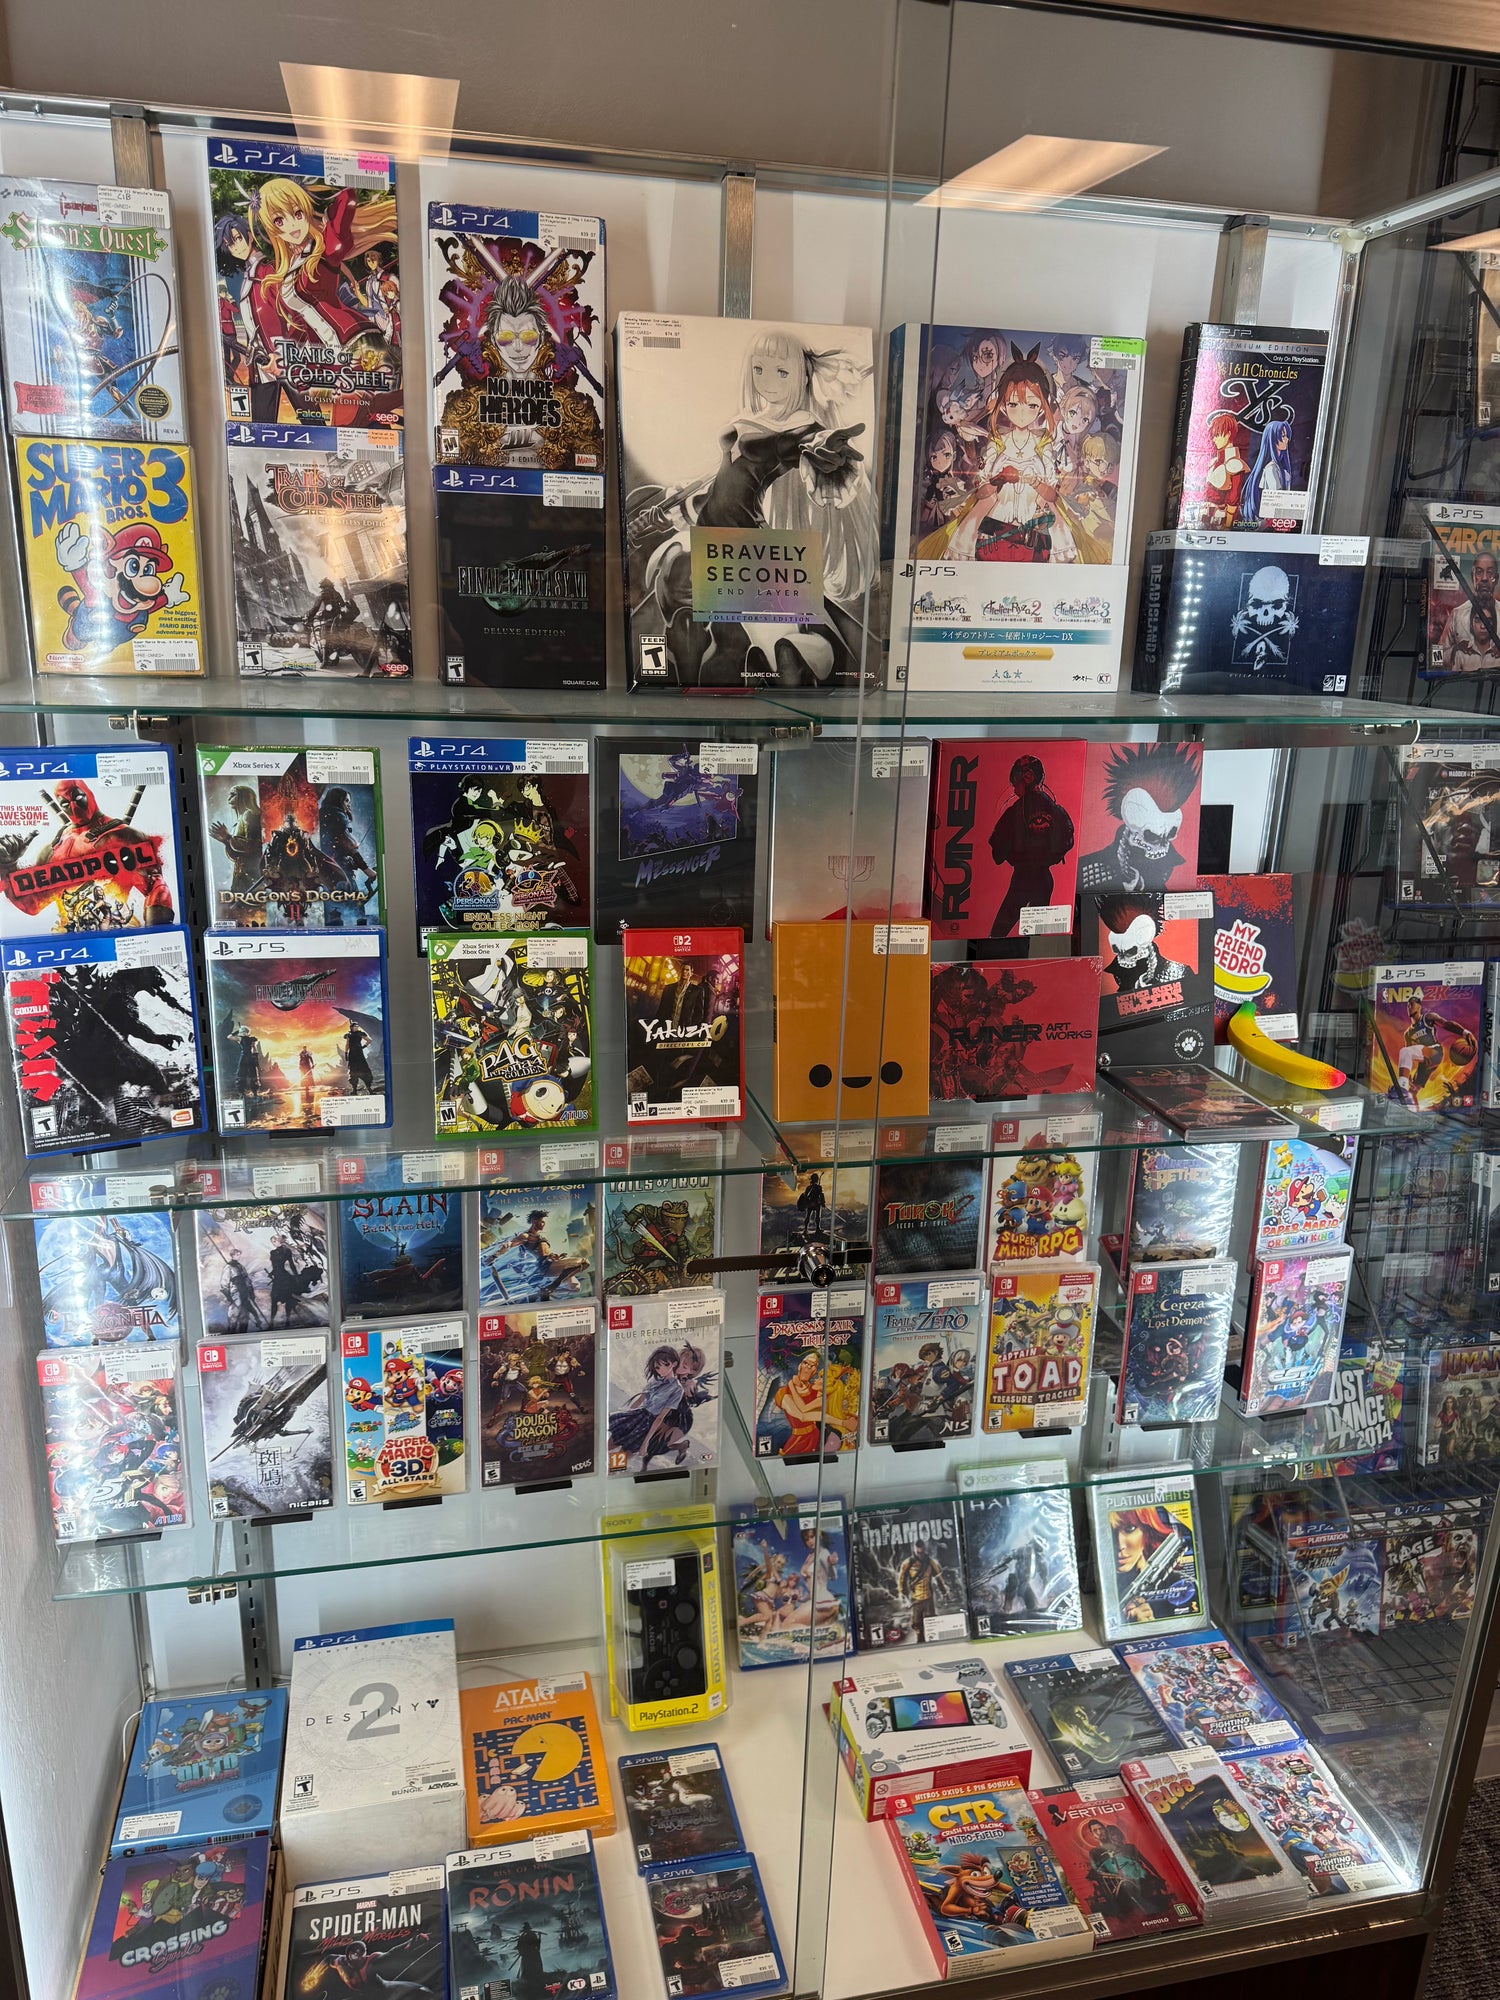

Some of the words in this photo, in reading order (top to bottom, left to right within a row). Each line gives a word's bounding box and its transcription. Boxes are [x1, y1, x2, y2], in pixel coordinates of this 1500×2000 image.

[244, 149, 300, 168] PS4
[461, 212, 512, 229] PS4
[274, 340, 335, 365] TRAILS
[337, 352, 353, 363] OF
[287, 363, 336, 389] COLD
[339, 367, 393, 392] STEEL
[511, 378, 553, 398] MORE
[339, 397, 371, 406] EDITION
[479, 395, 562, 428] HEROES
[261, 430, 314, 444] PS4
[26, 443, 147, 491] SUPER
[146, 448, 189, 524] 3
[469, 474, 519, 488] PS4
[29, 475, 147, 538] MARIO
[333, 489, 382, 514] STEEL
[105, 506, 148, 524] BROS.
[1453, 509, 1483, 518] PS5
[1197, 536, 1227, 545] PS5
[707, 544, 806, 561] BRAVELY
[707, 567, 807, 584] SECOND
[919, 566, 957, 577] PS5
[458, 566, 500, 595] FINAL
[507, 567, 574, 598] FANTASY
[758, 589, 799, 597] LAYER
[483, 627, 521, 636] DELUXE
[525, 628, 567, 637] EDITION
[941, 632, 995, 640] ライザのアトリエ
[1062, 633, 1073, 641] DX
[440, 745, 488, 756] PS4
[1424, 749, 1454, 758] PS5
[16, 762, 70, 775] PS4
[943, 755, 978, 920] RUINER
[14, 845, 151, 893] DEADPOOL
[635, 845, 721, 888] MESSENGER
[219, 890, 300, 904] DRAGON'S
[305, 890, 368, 903] DOGMA
[463, 912, 511, 922] ENDLESS
[513, 911, 548, 921] NIGHT
[472, 922, 540, 931] COLLECTION
[1234, 923, 1255, 941] MY
[238, 942, 286, 953] PS5
[684, 935, 691, 946] 2
[1217, 933, 1262, 961] FRIEND
[36, 947, 92, 962] PS4
[1214, 950, 1261, 974] PEDRO
[1397, 970, 1425, 978] PS5
[14, 1004, 48, 1016] GODZILLA
[1046, 1022, 1071, 1032] ART
[1046, 1030, 1092, 1040] WORKS
[560, 1111, 588, 1120] ATLUS
[352, 1193, 447, 1218] SLAIN
[361, 1223, 391, 1234] Back
[416, 1219, 441, 1231] Hell
[1261, 1222, 1300, 1237] PAPER
[1301, 1218, 1340, 1232] MARIO
[1001, 1231, 1037, 1246] SUPER
[1038, 1228, 1080, 1255] RPG
[1267, 1234, 1308, 1249] ORIGAMI
[1310, 1231, 1334, 1243] KING
[998, 1244, 1036, 1259] MARIO
[1160, 1299, 1205, 1313] Cereza
[1147, 1317, 1170, 1328] Lost
[615, 1330, 637, 1340] BLUE
[997, 1348, 1037, 1363] CAPTAIN
[993, 1359, 1082, 1391] TOAD
[992, 1394, 1033, 1404] TREASURE
[1038, 1388, 1079, 1402] TRACKER
[515, 1413, 557, 1428] DOUBLE
[940, 1420, 969, 1434] NIS
[1325, 1394, 1386, 1449] DANCE
[513, 1423, 558, 1440] DRAGON
[1356, 1421, 1393, 1449] 2014
[386, 1436, 428, 1449] SUPER
[378, 1445, 436, 1462] MARIO
[611, 1453, 625, 1467] 12
[391, 1461, 423, 1478] 3D
[289, 1499, 329, 1508] nicalis
[1106, 1490, 1164, 1507] PLATINUM
[1164, 1491, 1190, 1501] HITS
[862, 1519, 953, 1546] inFAMOUS
[320, 1635, 358, 1646] PS4
[1136, 1641, 1169, 1650] PS4
[1028, 1661, 1060, 1671] PS4
[306, 1702, 420, 1726] DESTINY
[347, 1682, 400, 1741] 2
[503, 1712, 551, 1725] PAC-MAN
[1209, 1717, 1250, 1730] FIGHTING
[942, 1788, 964, 1797] OXIDE
[974, 1783, 985, 1791] PIN
[988, 1779, 1015, 1789] BUNDLE
[1145, 1779, 1195, 1814] BLOB
[928, 1800, 1006, 1829] CTR
[1055, 1802, 1125, 1822] VERTIGO
[941, 1827, 962, 1836] CRASH
[980, 1822, 1004, 1830] RACING
[948, 1829, 1004, 1845] NITRO-FUELED
[473, 1850, 512, 1863] PS5
[1315, 1855, 1351, 1867] FIGHTING
[321, 1887, 362, 1898] PS5
[469, 1873, 575, 1912] RŌNIN
[356, 1900, 377, 1910] MARVEL
[309, 1904, 422, 1941] SPIDER-MAN
[1141, 1918, 1170, 1926] PENDULO
[121, 1921, 229, 1967] CROSSING
